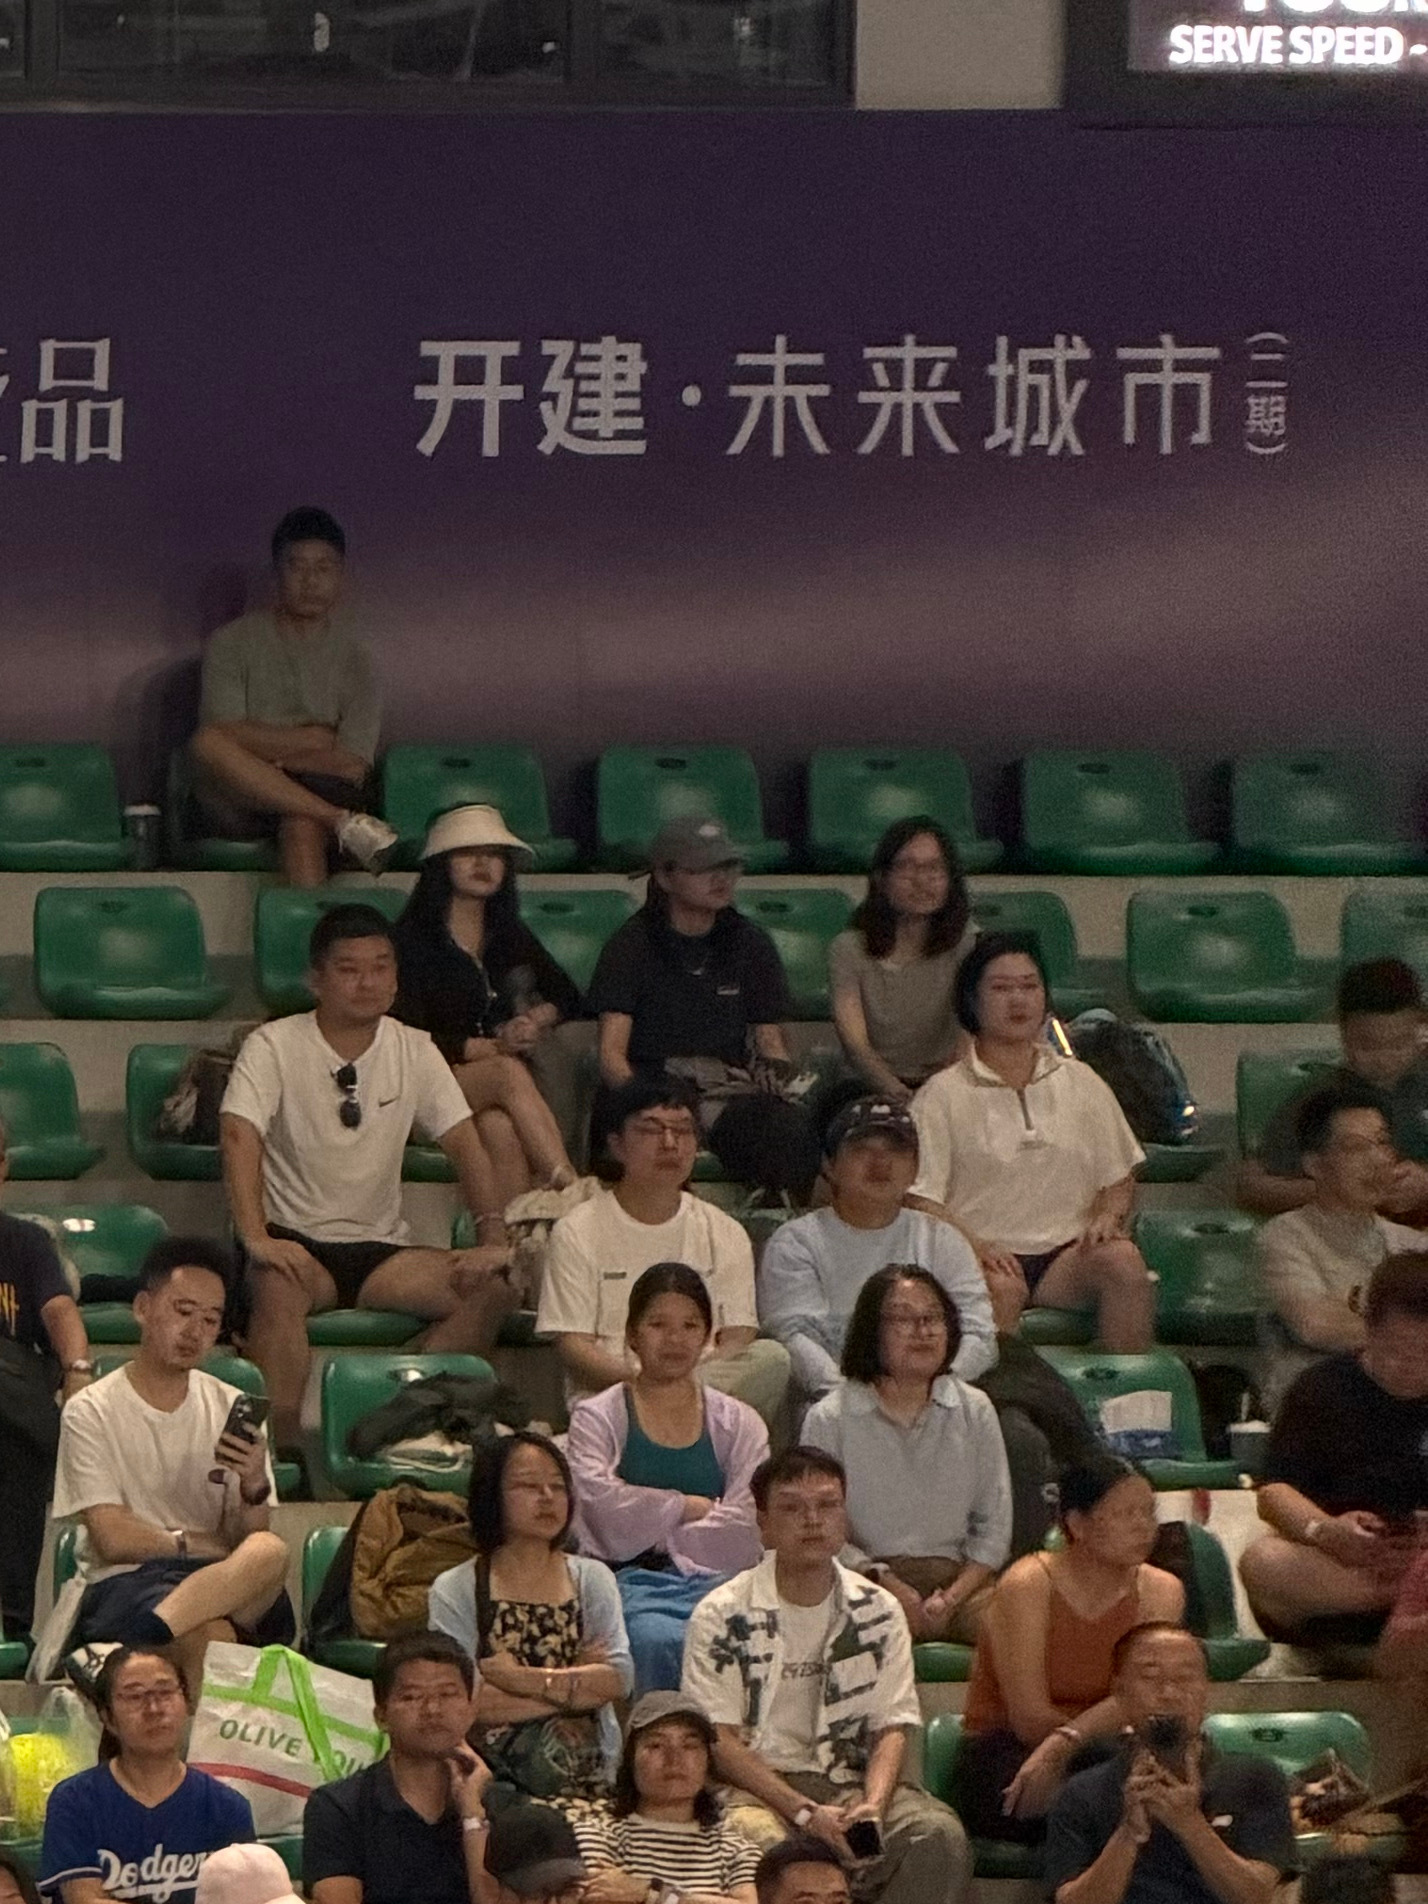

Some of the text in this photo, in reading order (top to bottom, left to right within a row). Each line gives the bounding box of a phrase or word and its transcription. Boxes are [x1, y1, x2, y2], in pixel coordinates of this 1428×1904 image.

[1169, 25, 1405, 66] SERVE SPEED
[413, 333, 1222, 457] 开建·未来城市
[219, 1719, 302, 1757] OLIVE
[97, 1843, 212, 1904] Dodger
